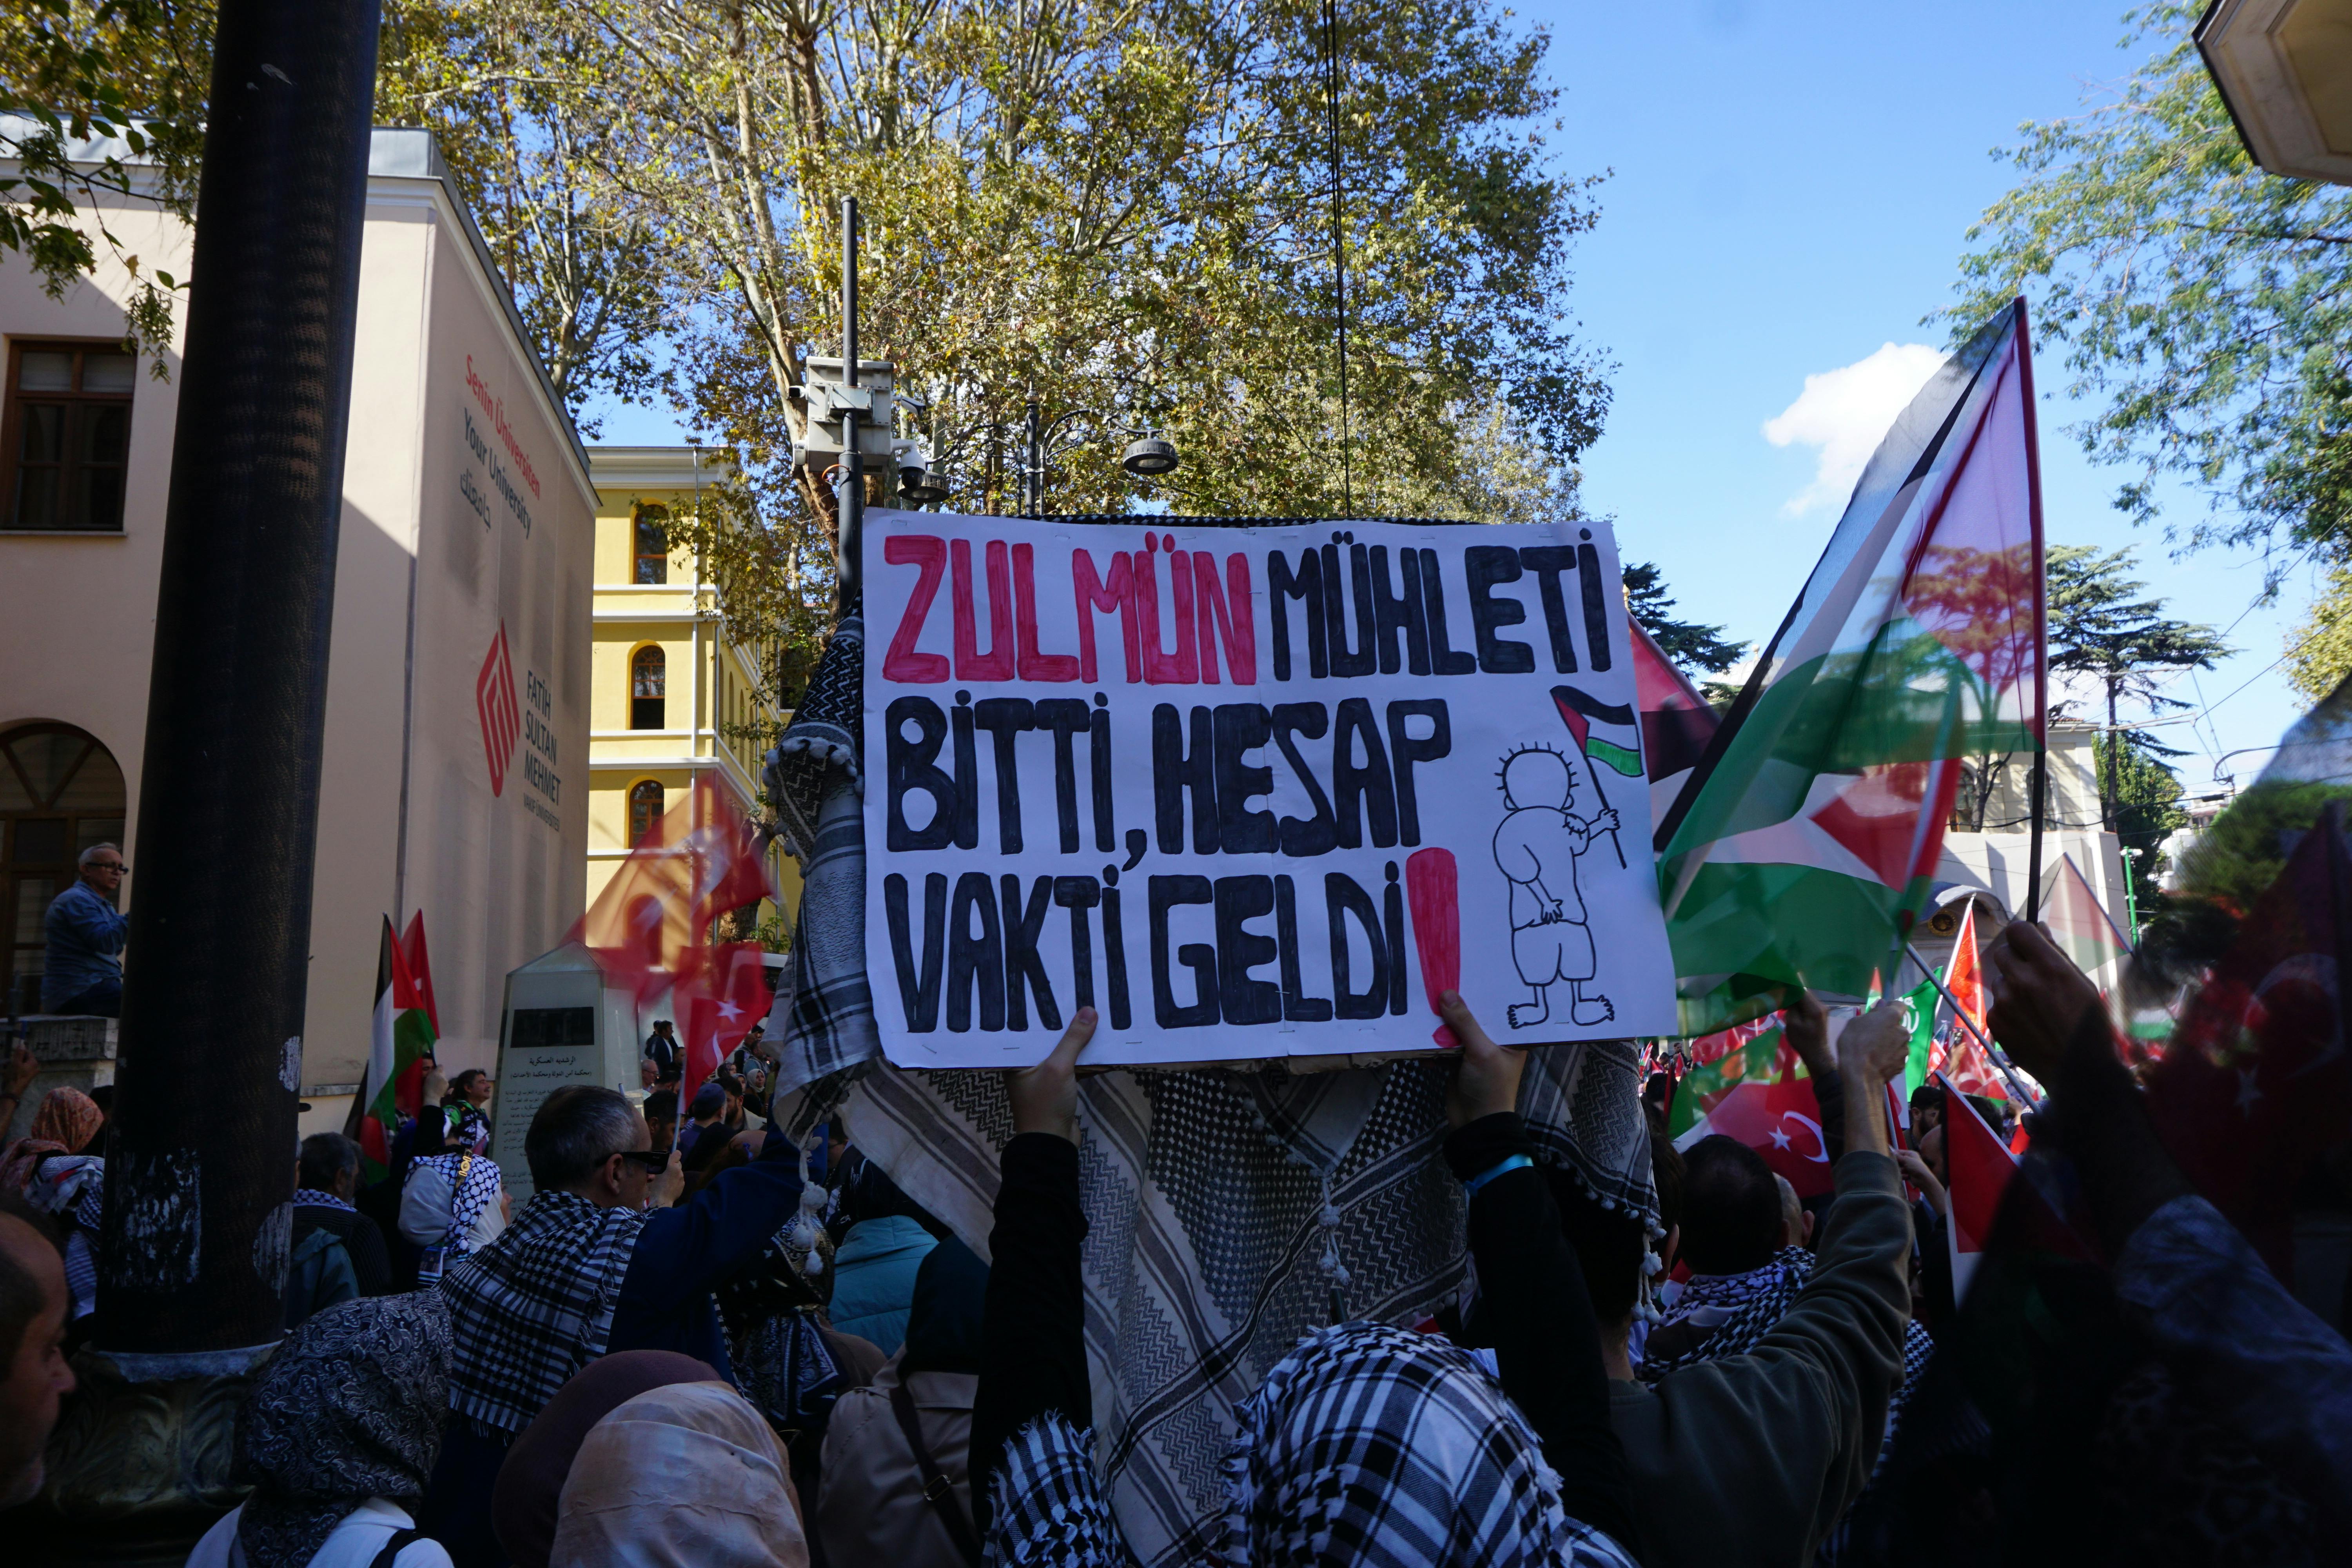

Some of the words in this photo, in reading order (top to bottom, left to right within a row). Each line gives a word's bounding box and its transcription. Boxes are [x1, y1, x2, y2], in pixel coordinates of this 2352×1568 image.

[464, 407, 487, 465] Your
[489, 447, 531, 539] University
[466, 354, 493, 421] Senin
[495, 397, 539, 500] Üniversiten
[1269, 528, 1610, 681] MÜHLETİ
[525, 709, 557, 766] SULTAN
[527, 670, 551, 720] FATİH
[524, 750, 561, 806] MEHMET
[1153, 697, 1451, 857] HESAP
[884, 864, 1132, 1033] VAKTİ
